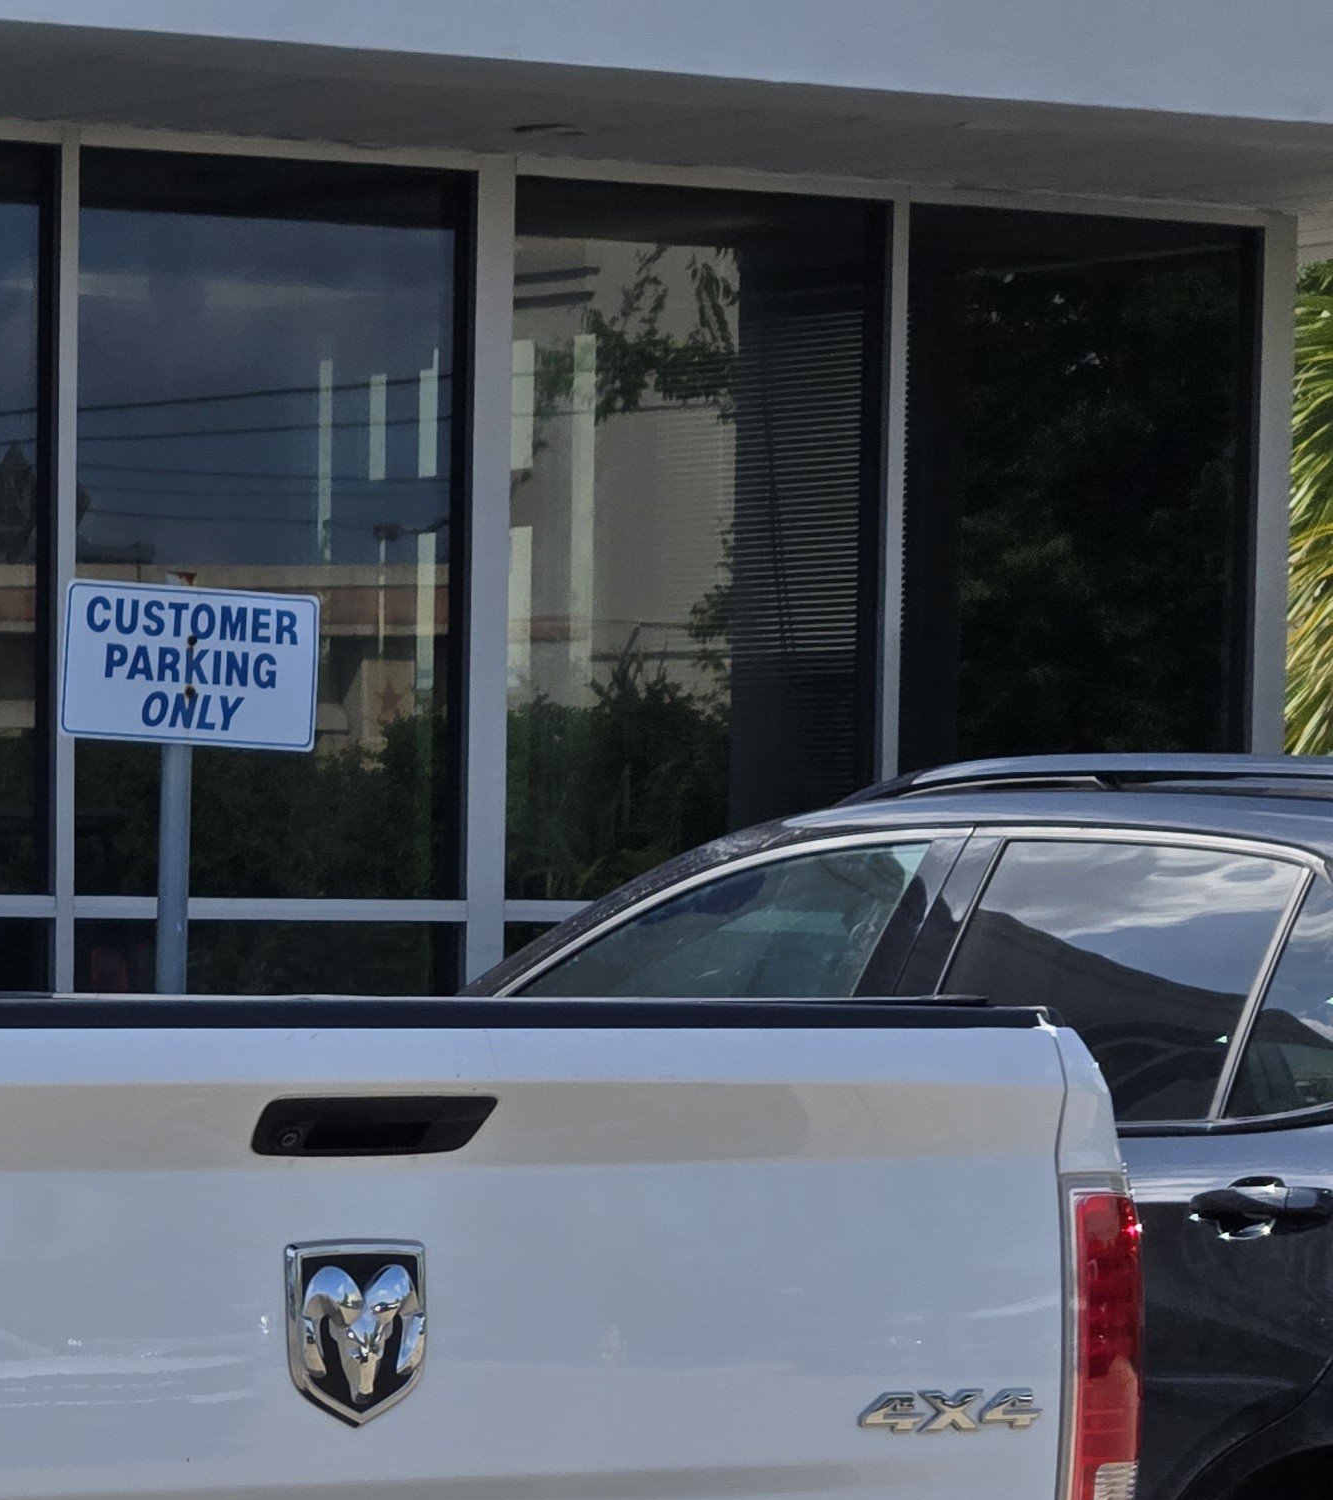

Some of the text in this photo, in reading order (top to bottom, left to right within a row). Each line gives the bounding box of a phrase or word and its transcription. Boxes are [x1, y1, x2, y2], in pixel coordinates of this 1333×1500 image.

[86, 595, 299, 646] CUSTOMER
[104, 643, 277, 689] PARKING
[141, 690, 245, 731] ONLY
